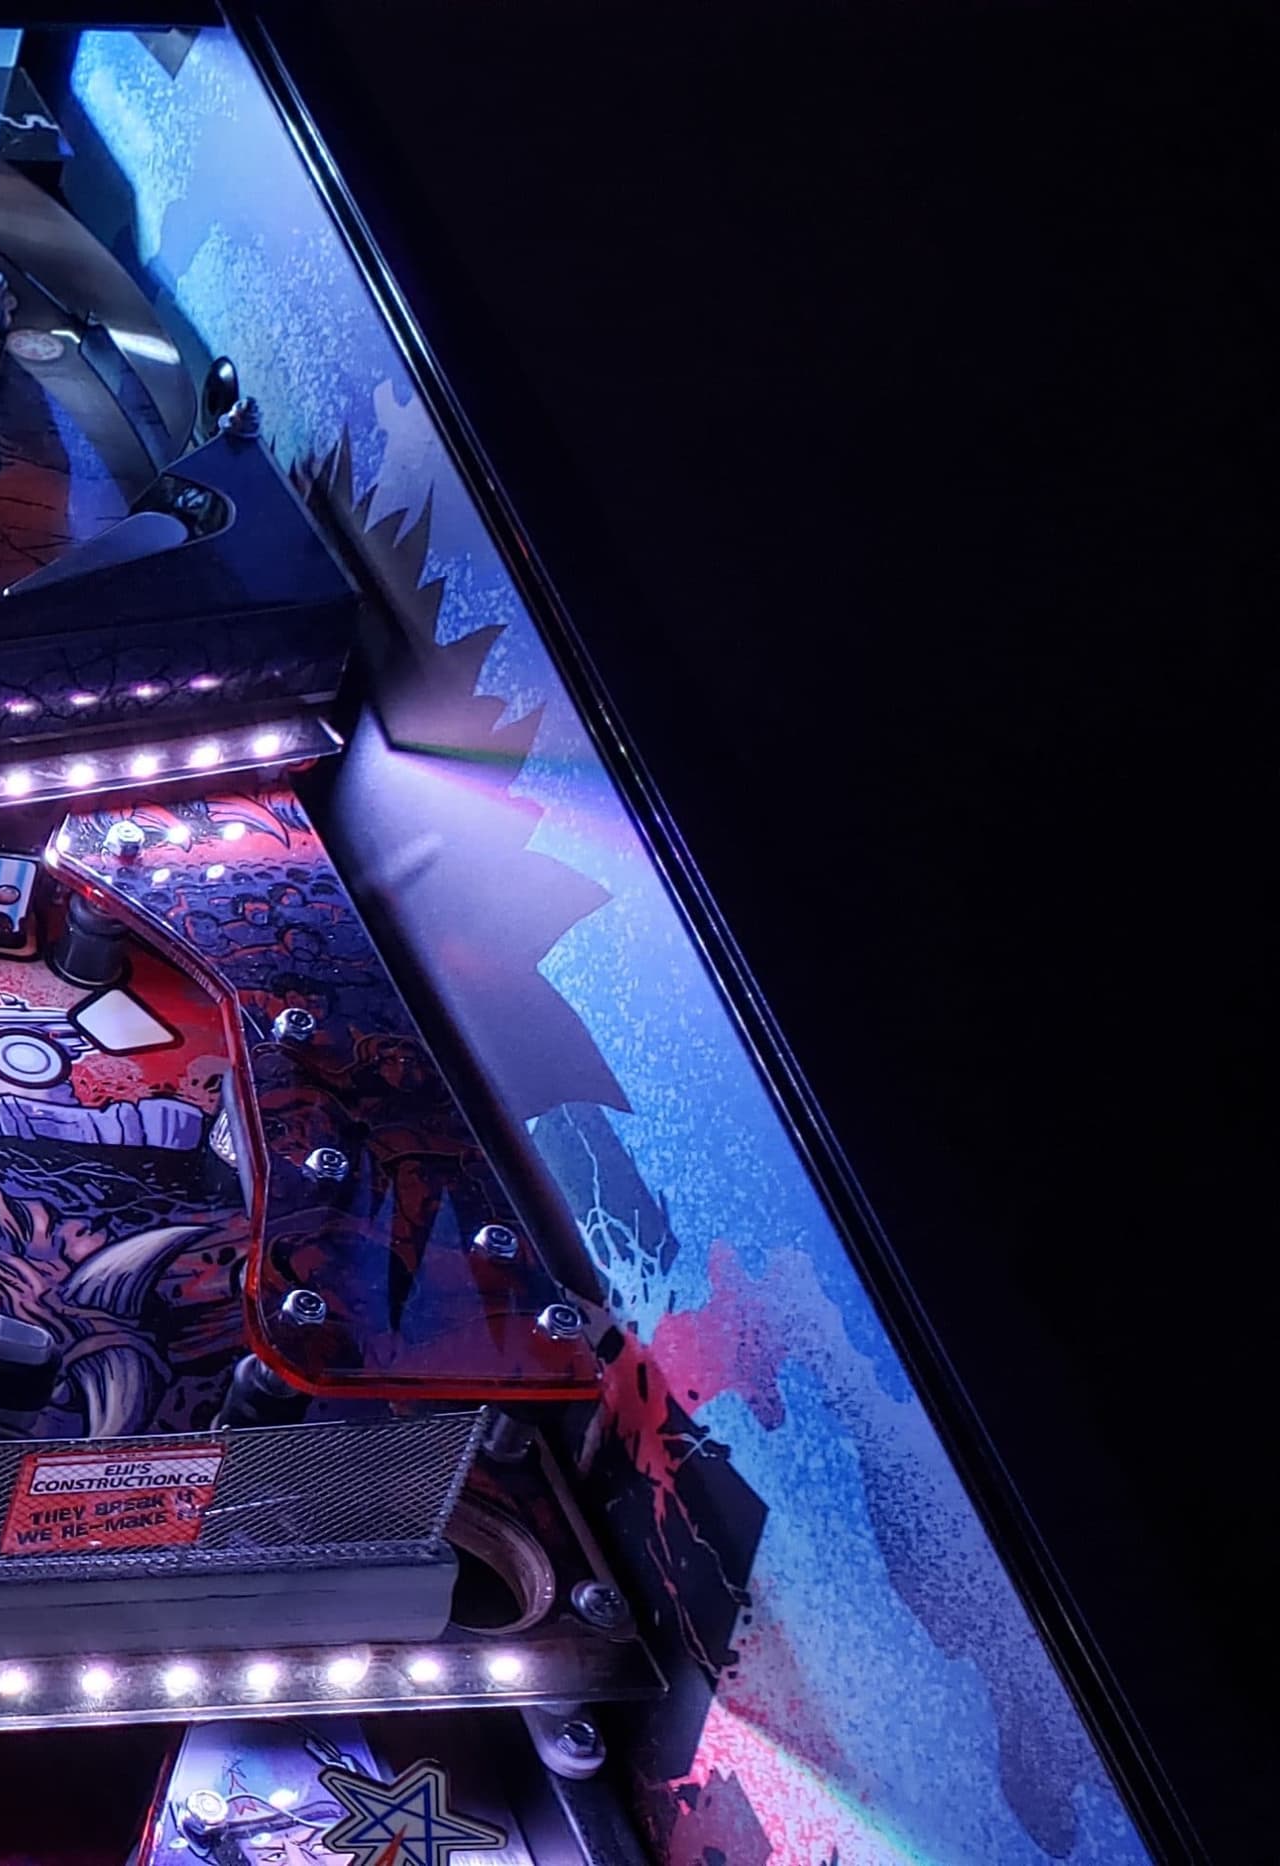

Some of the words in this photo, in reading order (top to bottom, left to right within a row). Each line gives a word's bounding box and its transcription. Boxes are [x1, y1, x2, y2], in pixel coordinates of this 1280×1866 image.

[32, 1473, 182, 1493] CONSTRUCTION
[30, 1505, 85, 1525] THEY
[16, 1528, 53, 1545] WE
